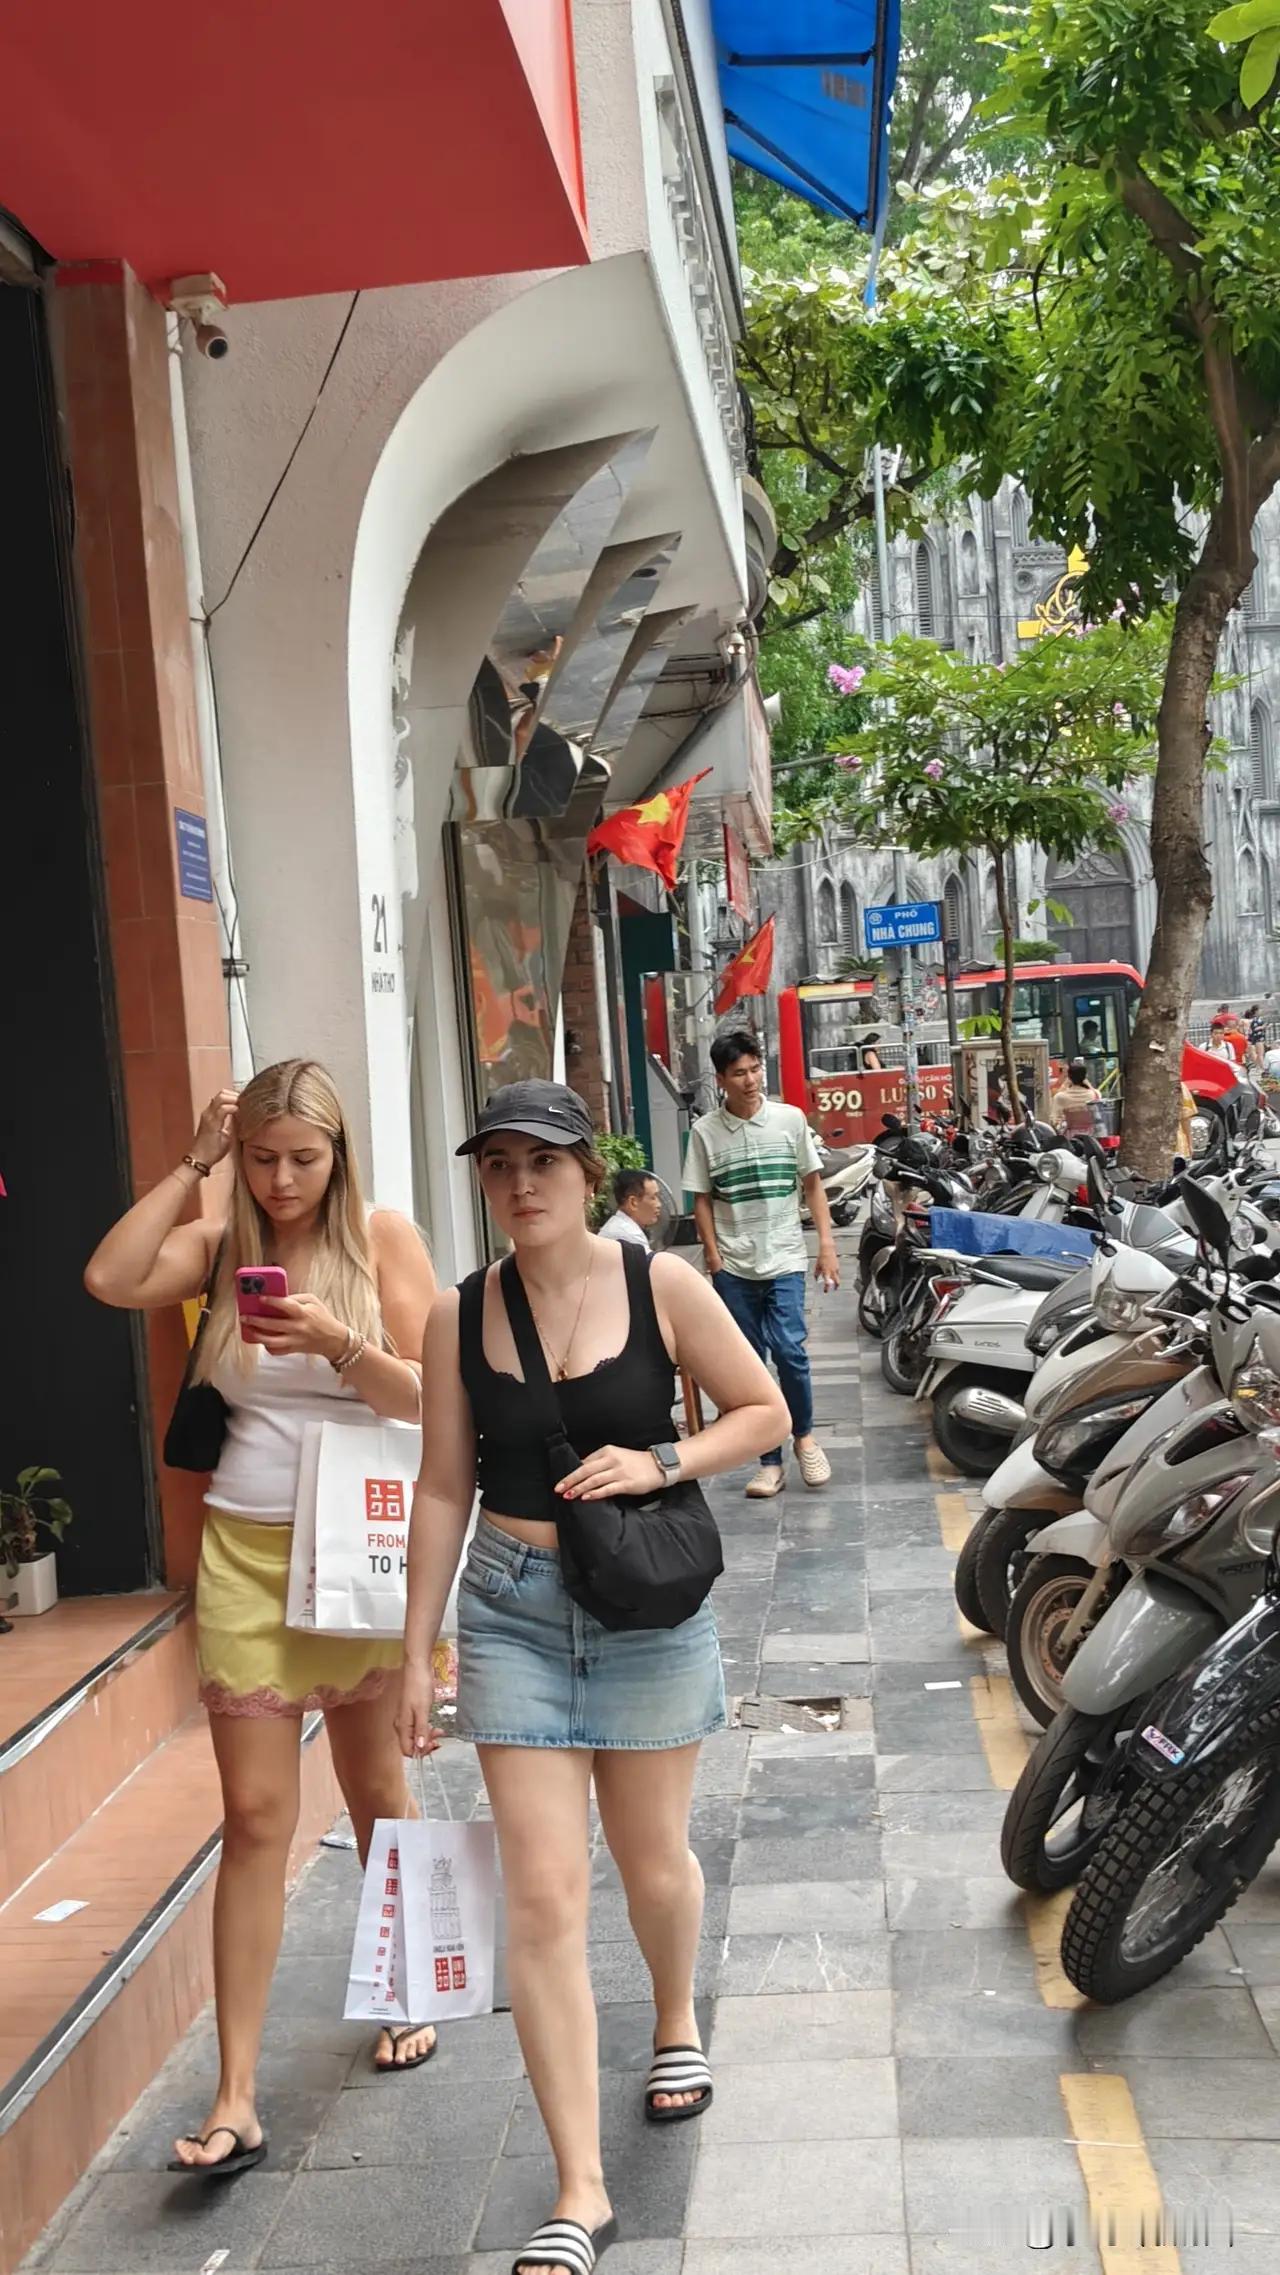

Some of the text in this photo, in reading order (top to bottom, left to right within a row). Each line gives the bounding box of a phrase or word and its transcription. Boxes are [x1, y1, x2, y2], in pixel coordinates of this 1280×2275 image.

[872, 922, 935, 941] NHÀ CHUNG
[818, 1090, 862, 1111] 390
[368, 1534, 406, 1549] FROM
[368, 1555, 391, 1574] TO
